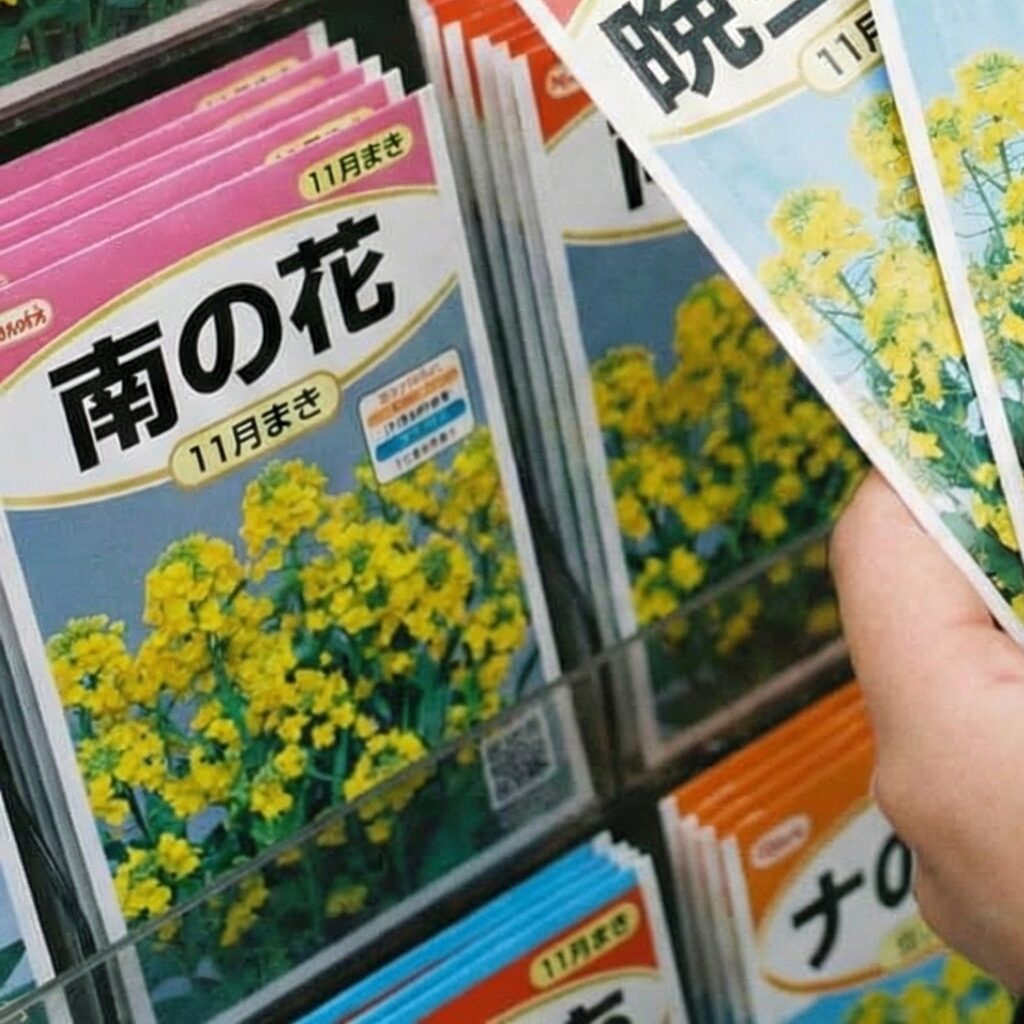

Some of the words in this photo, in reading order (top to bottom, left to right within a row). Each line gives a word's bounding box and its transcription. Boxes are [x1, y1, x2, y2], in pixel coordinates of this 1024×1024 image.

[308, 132, 404, 194] 11月まき
[47, 213, 396, 474] 南の花
[189, 386, 321, 473] 11月まき
[541, 912, 627, 979] 11月まき
